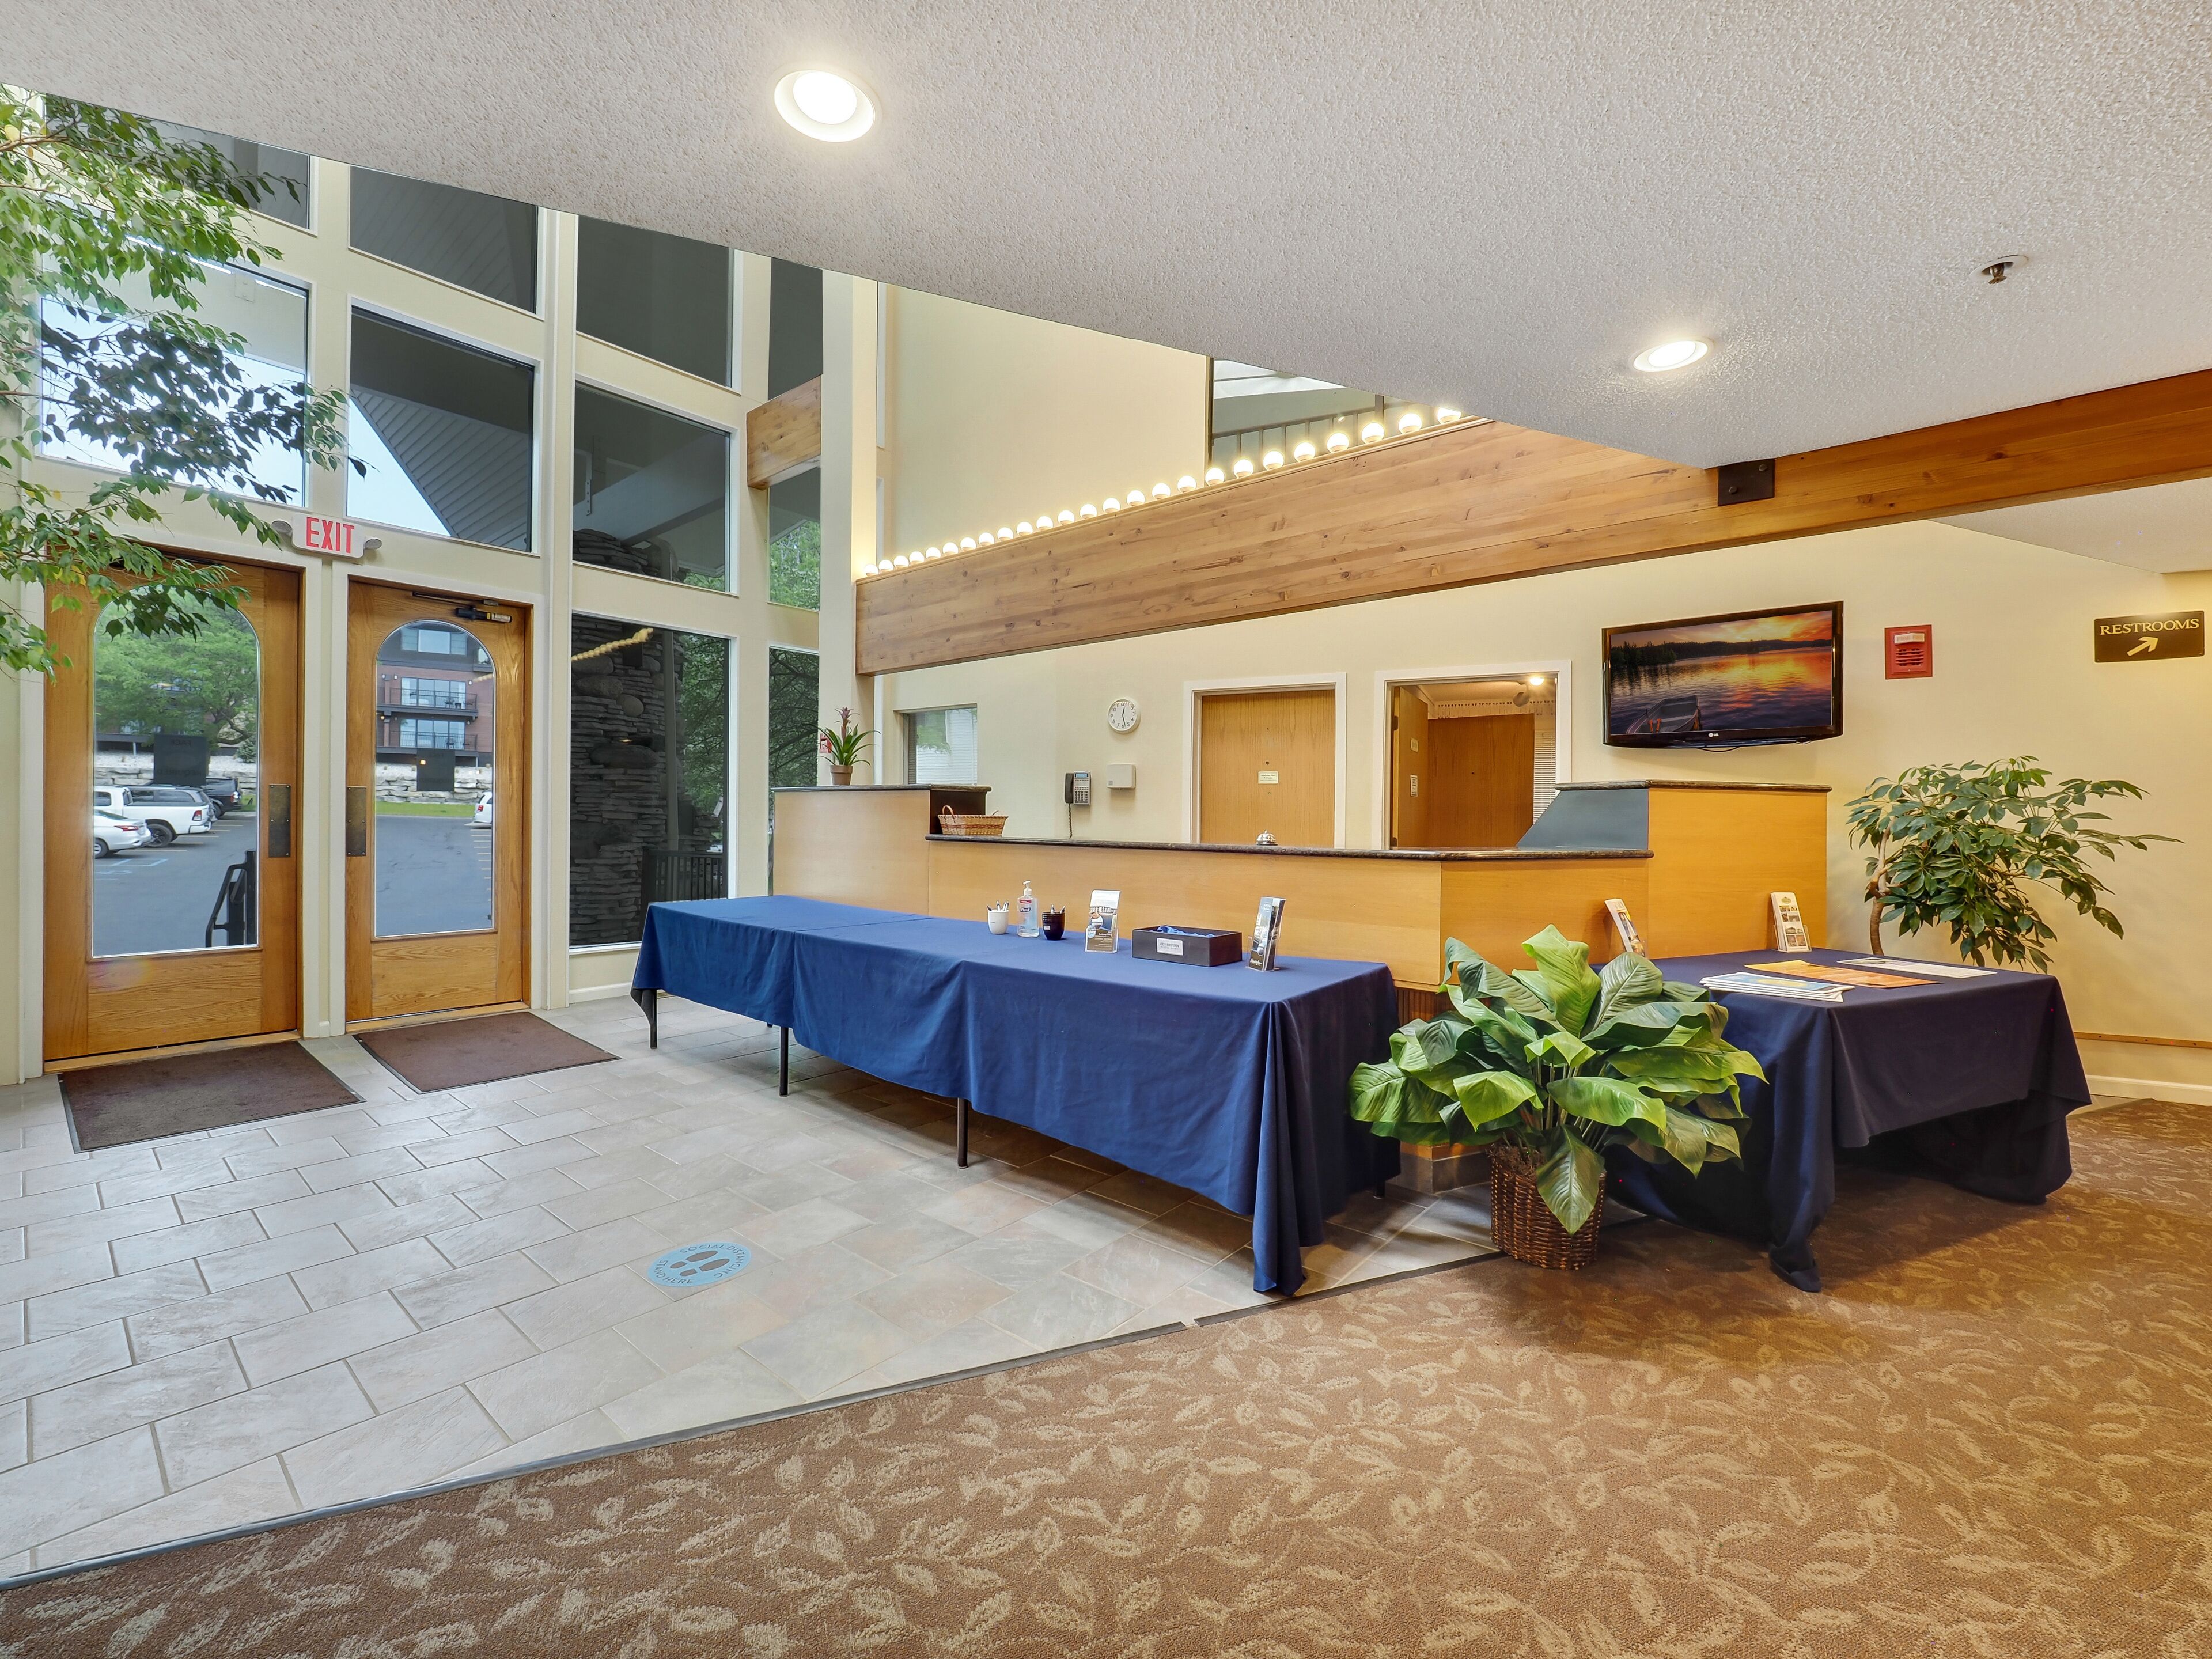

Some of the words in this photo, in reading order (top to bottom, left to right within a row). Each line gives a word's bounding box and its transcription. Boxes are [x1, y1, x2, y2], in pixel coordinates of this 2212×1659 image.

[306, 516, 355, 554] EXIT
[2100, 618, 2199, 635] RESTROOMS
[654, 1259, 669, 1278] STAND
[663, 1276, 694, 1284] HERE
[679, 1244, 725, 1254] SOCIAL
[714, 1245, 745, 1278] DISTANCING
